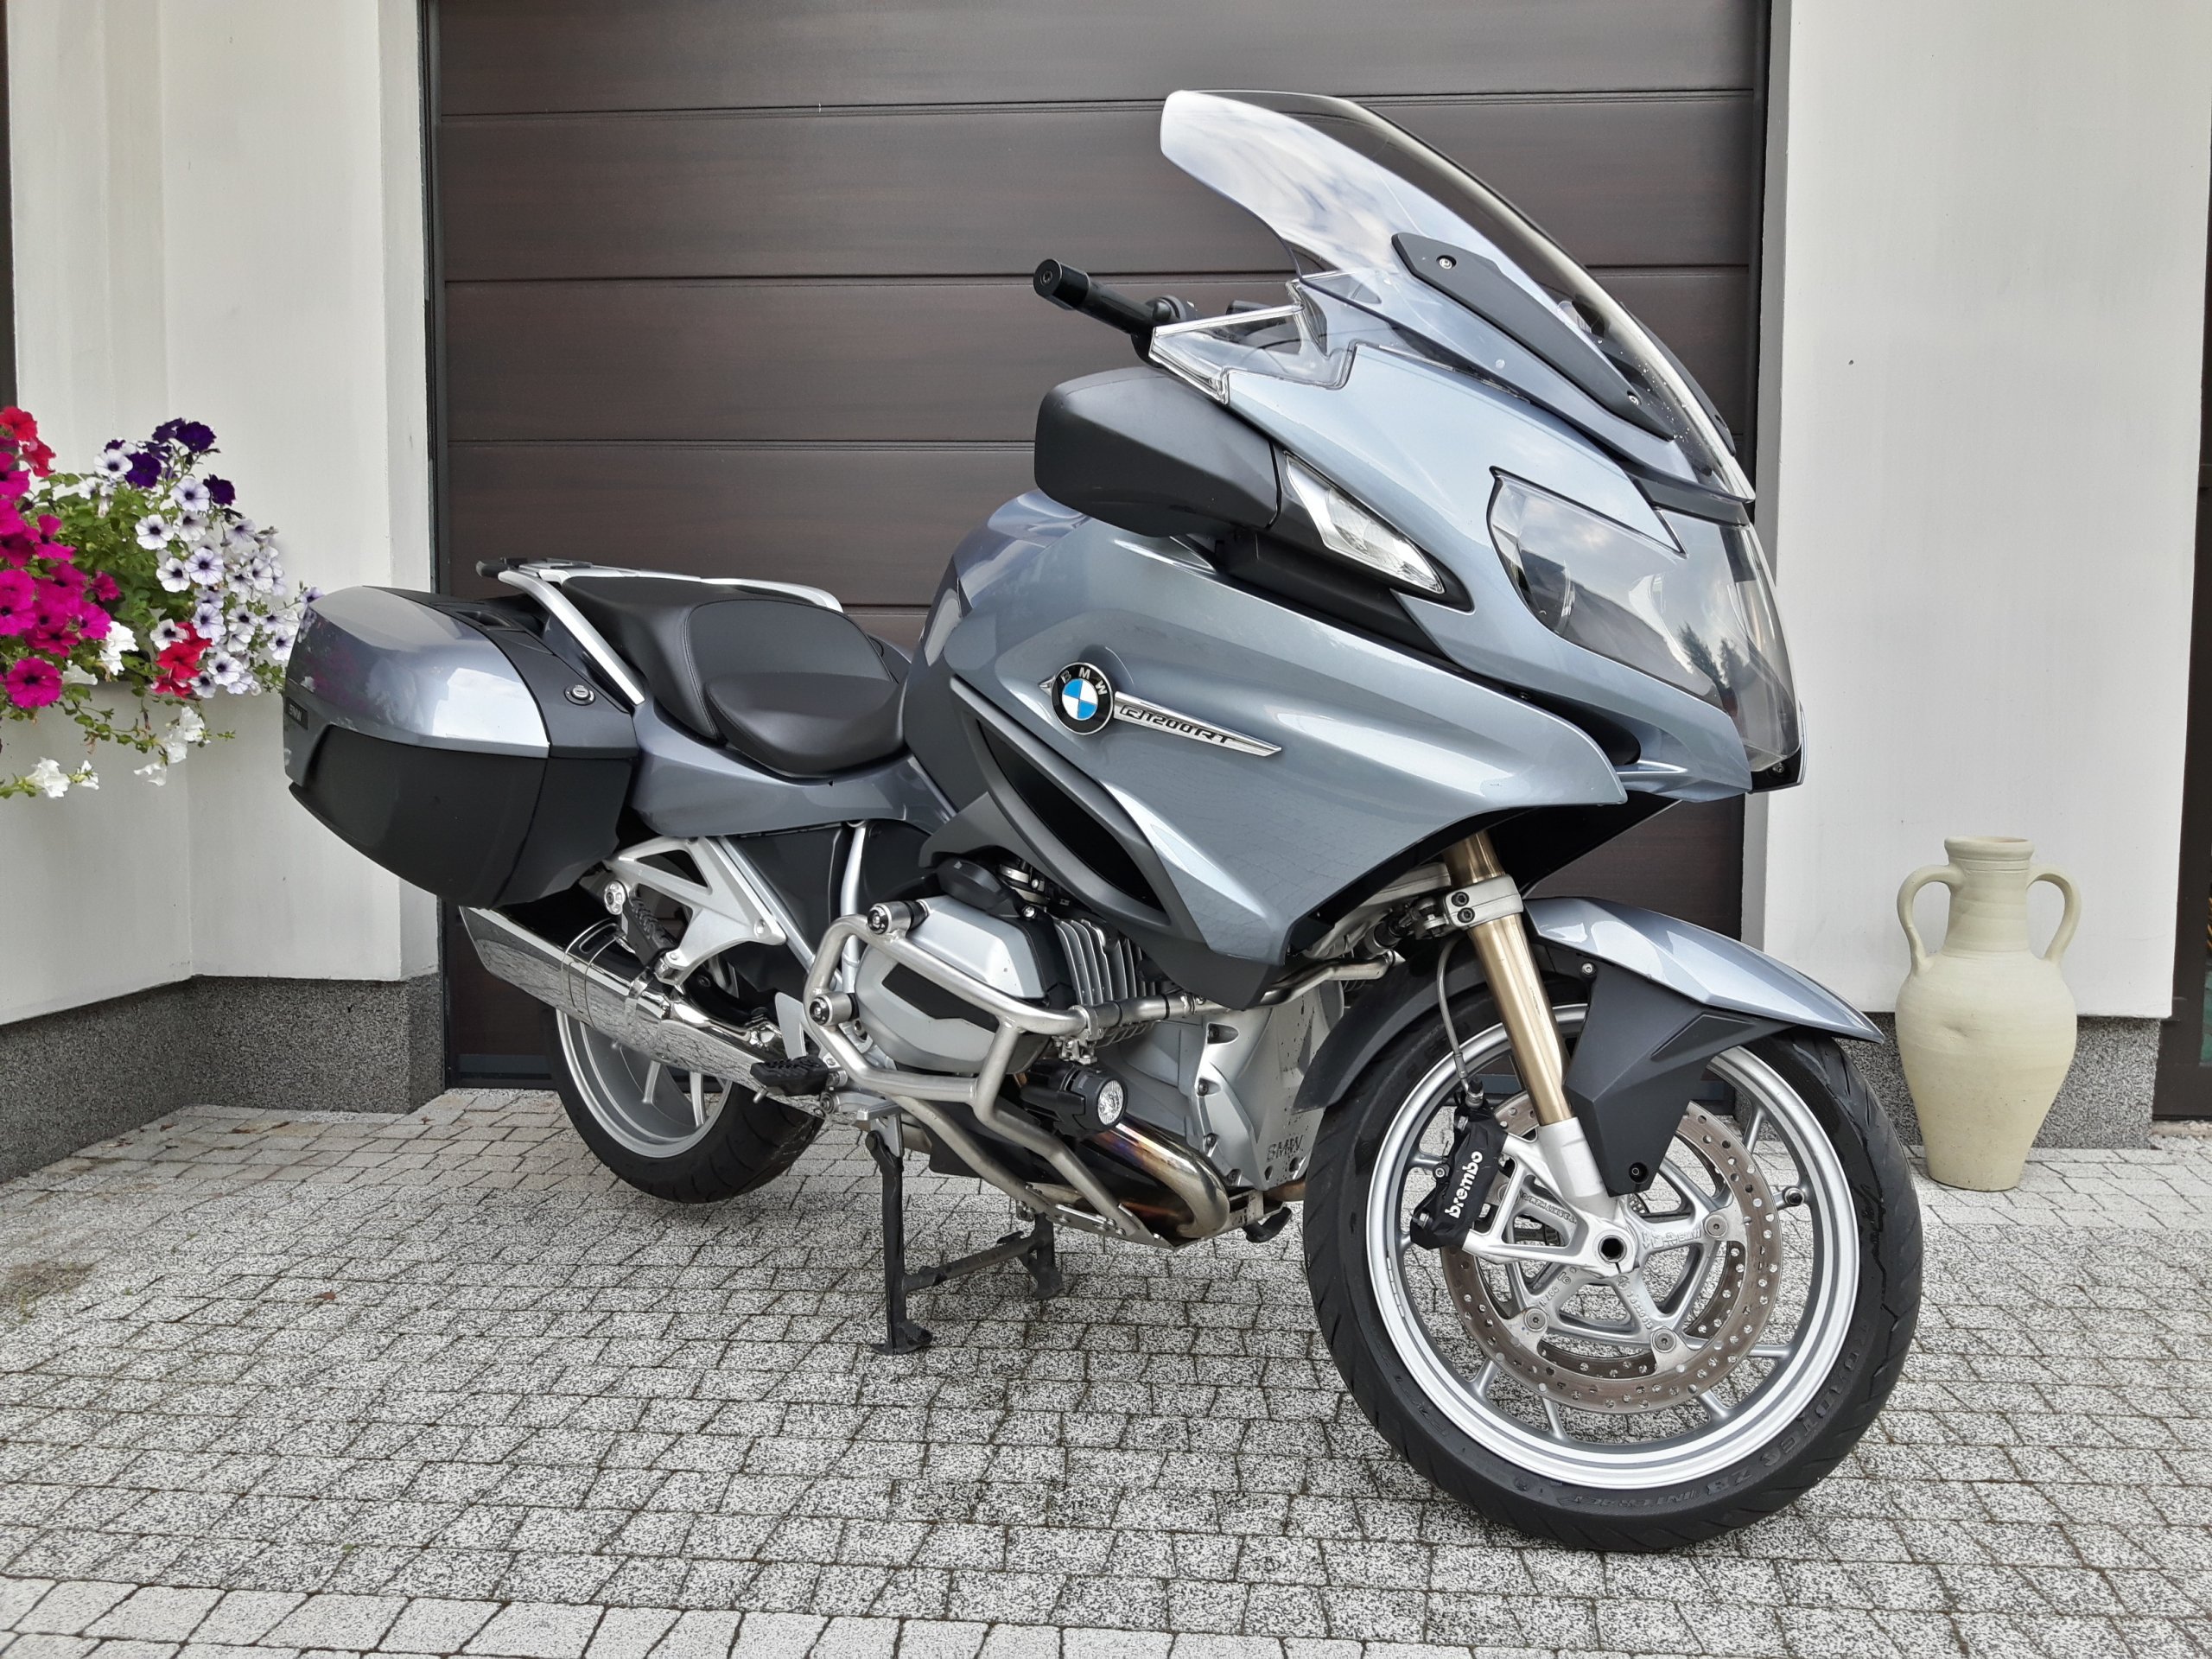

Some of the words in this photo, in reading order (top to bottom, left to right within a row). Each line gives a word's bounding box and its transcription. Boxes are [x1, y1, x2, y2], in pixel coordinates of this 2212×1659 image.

[1060, 666, 1108, 696] BMW
[1267, 1134, 1304, 1162] BMW
[1444, 1151, 1483, 1219] brembo
